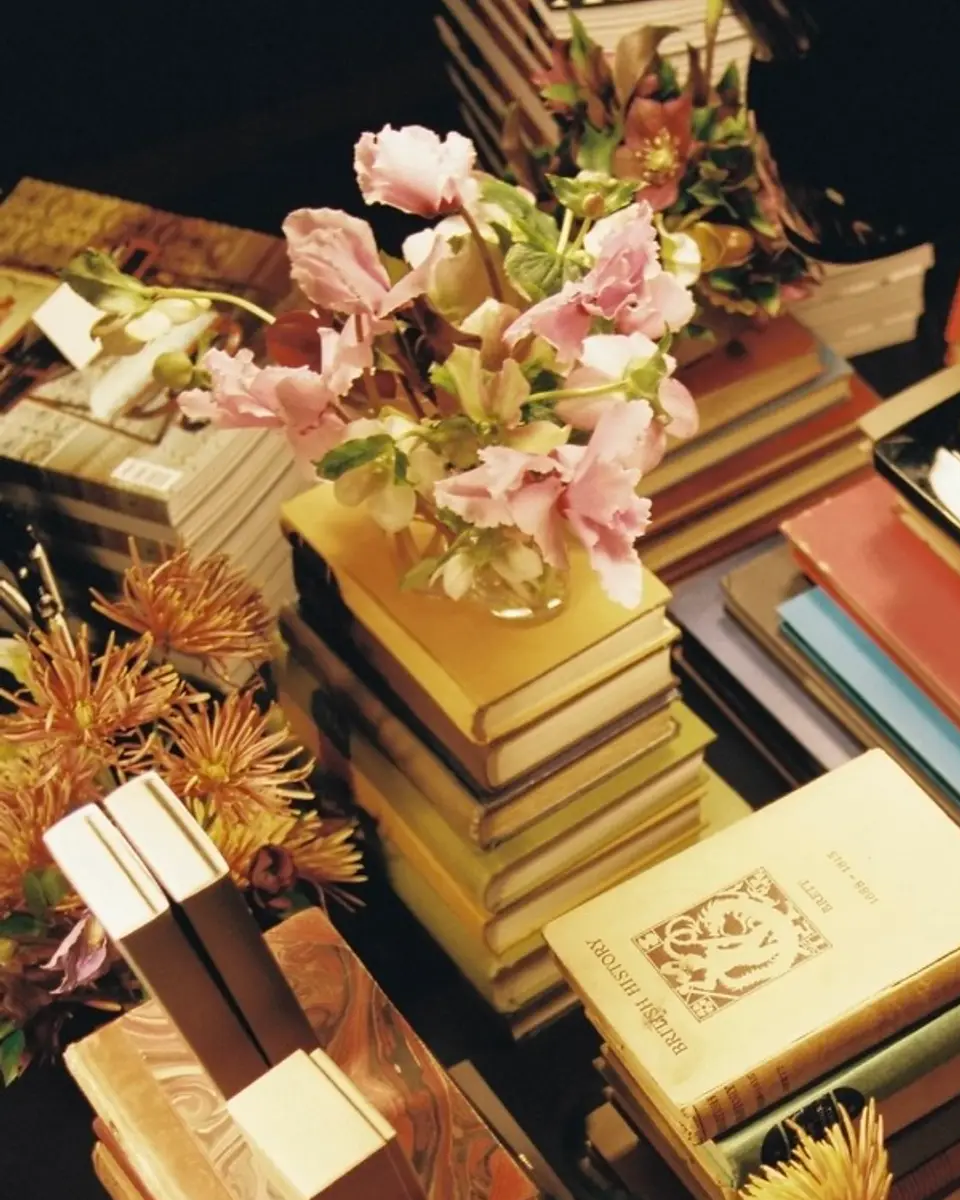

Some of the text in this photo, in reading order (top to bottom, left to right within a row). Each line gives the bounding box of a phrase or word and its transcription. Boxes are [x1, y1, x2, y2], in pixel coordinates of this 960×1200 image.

[797, 880, 834, 914] BRETT
[584, 938, 689, 1056] BRITISH HISTORY
